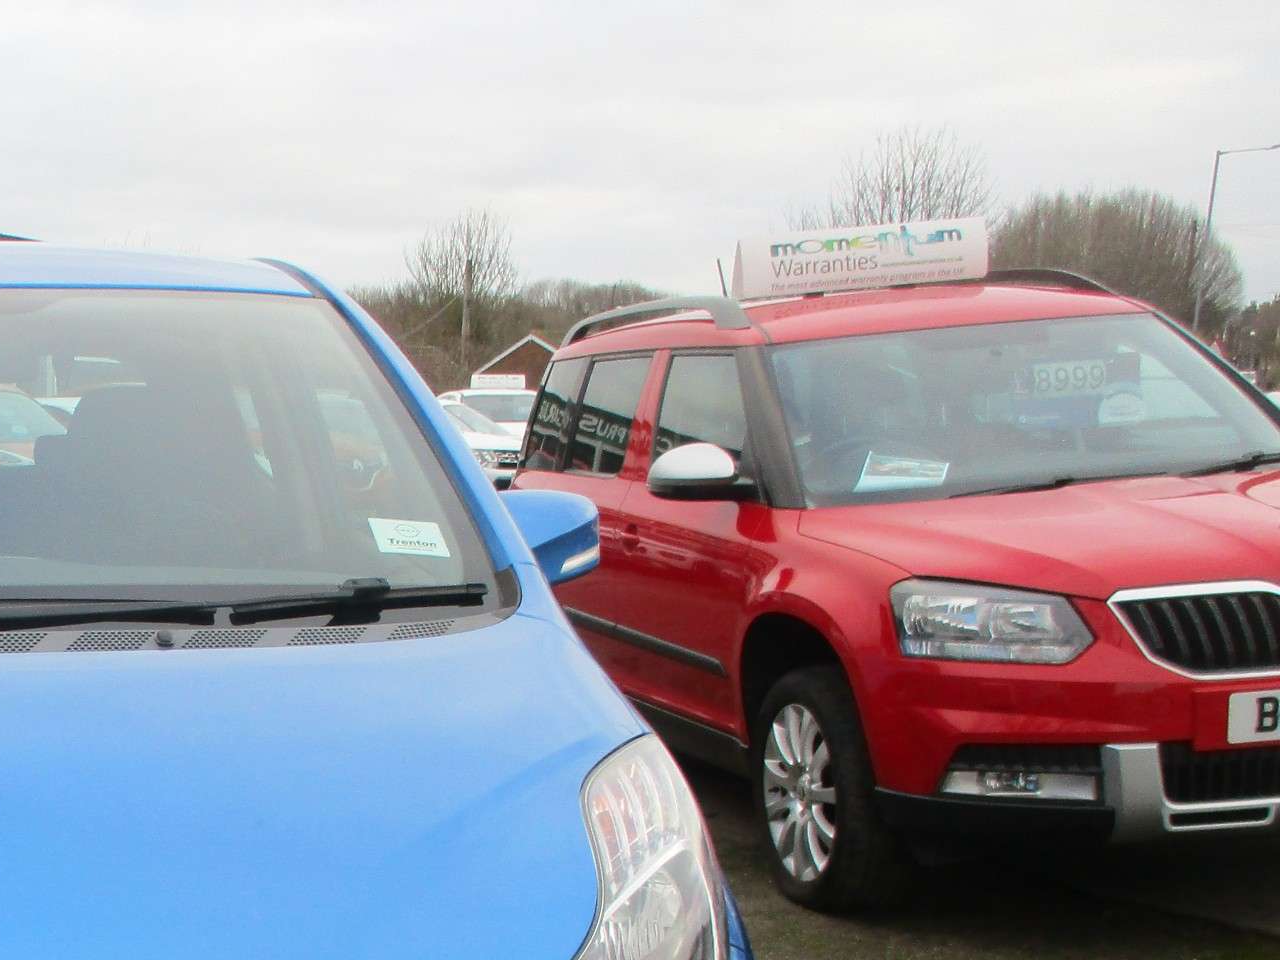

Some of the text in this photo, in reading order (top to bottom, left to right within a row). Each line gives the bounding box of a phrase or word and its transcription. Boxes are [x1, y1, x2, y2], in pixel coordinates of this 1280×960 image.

[771, 252, 878, 279] Warranties
[1036, 364, 1105, 393] 8999
[387, 537, 437, 549] Trenton
